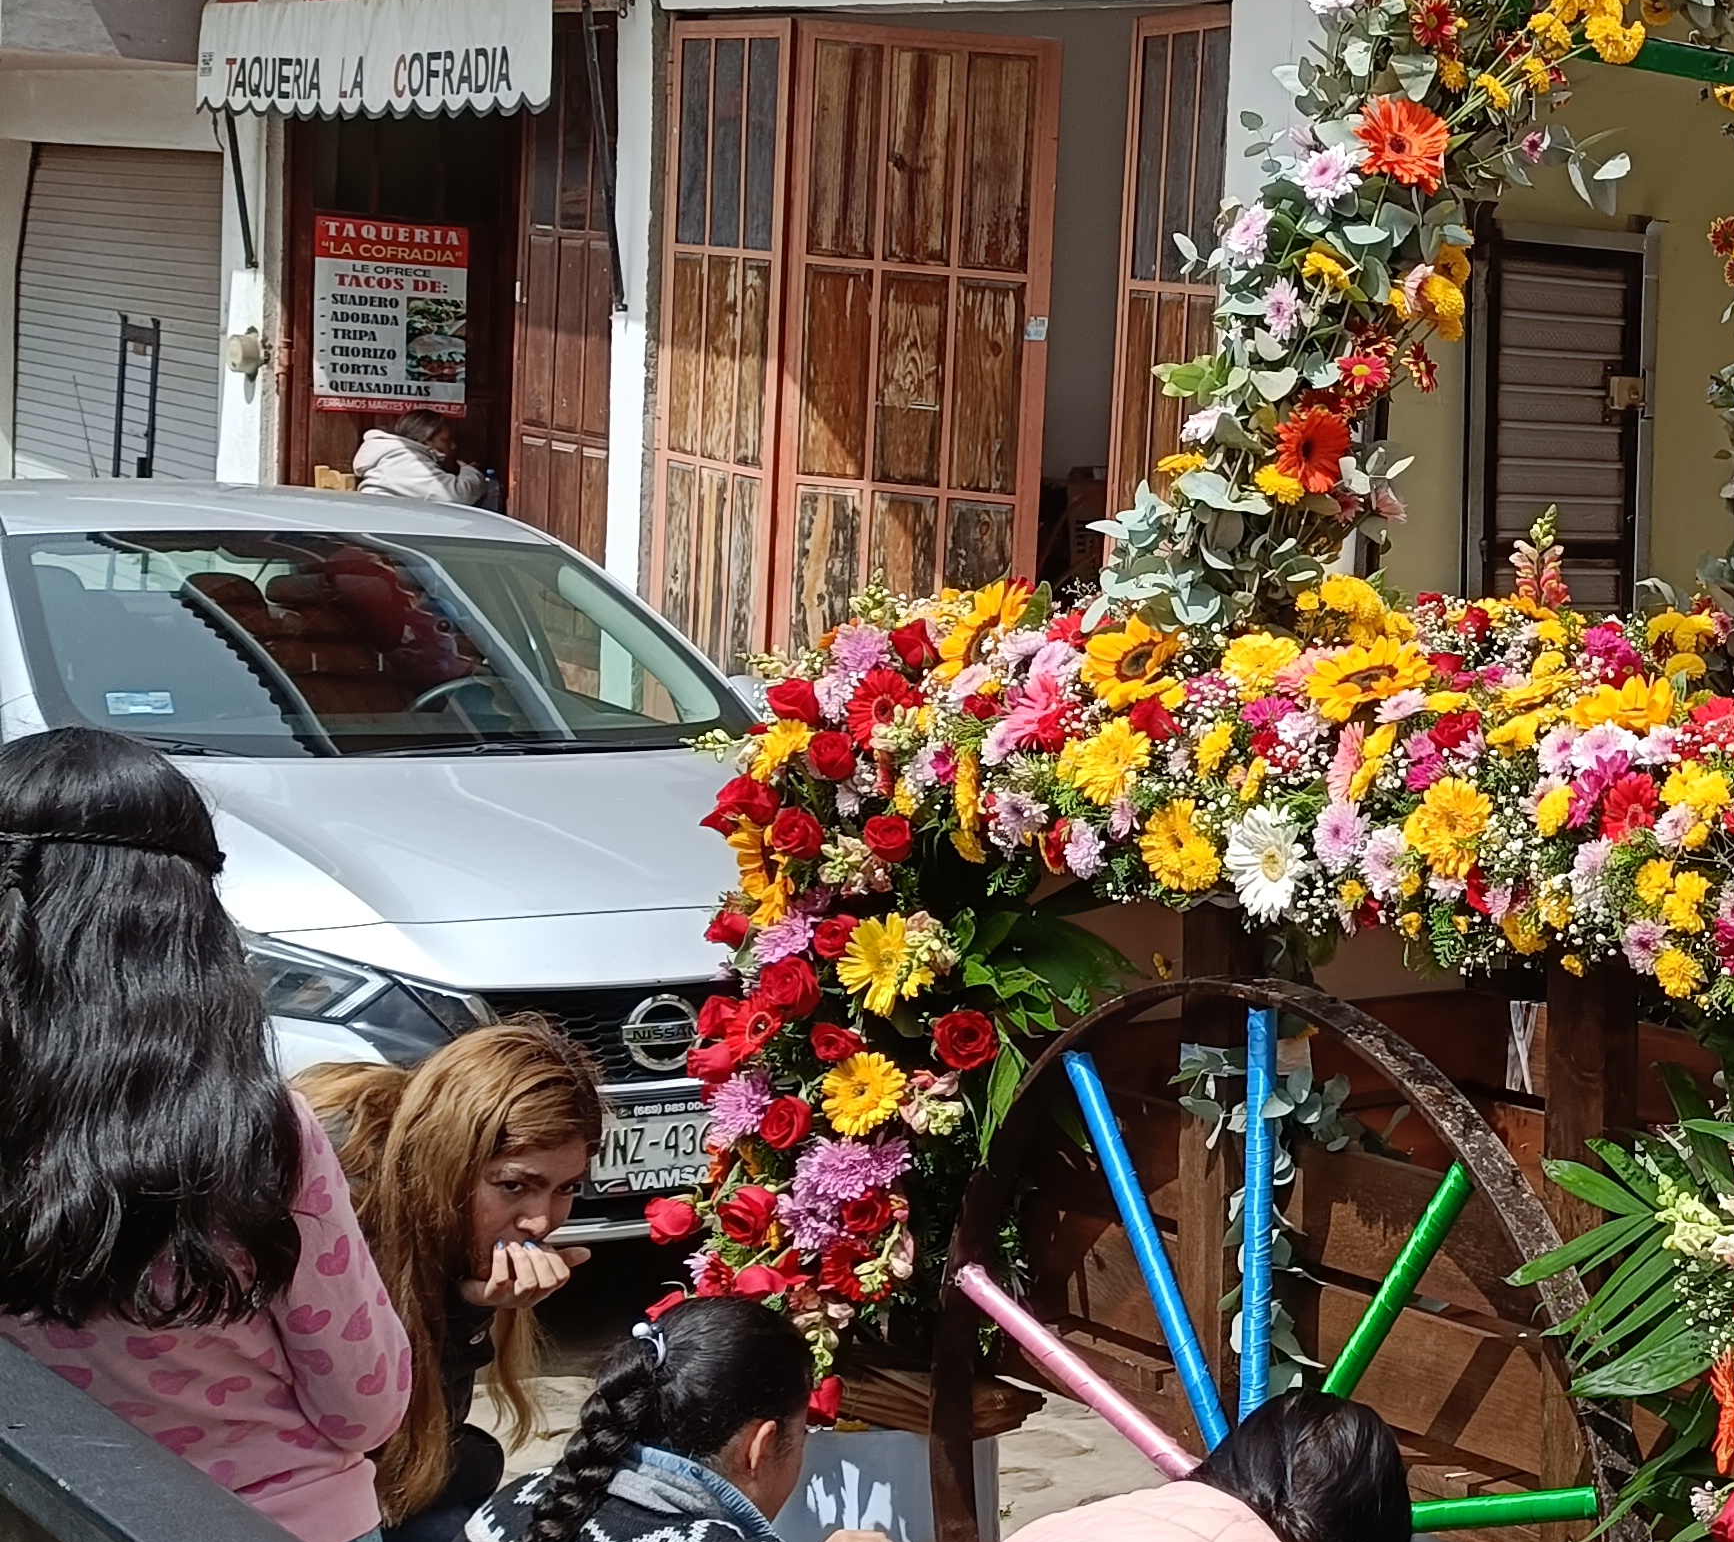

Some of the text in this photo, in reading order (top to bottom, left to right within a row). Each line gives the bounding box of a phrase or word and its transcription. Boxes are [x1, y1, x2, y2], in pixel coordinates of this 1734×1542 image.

[225, 56, 321, 100] TAQUERIA
[339, 56, 364, 99] LA
[394, 46, 512, 99] COFRADIA
[325, 221, 460, 246] TAQUERIA
[352, 263, 432, 278] LE OFRECE
[335, 273, 449, 294] TACOS DE:
[331, 293, 400, 309] SUADERO
[330, 311, 400, 327] ADOBADA
[331, 328, 378, 342] TRIPA
[331, 345, 397, 360] CHORIZO
[330, 362, 388, 377] TORTAS
[329, 380, 431, 397] QUEASADILLAS
[368, 399, 405, 411] MARTES
[632, 1024, 699, 1041] NISSAN
